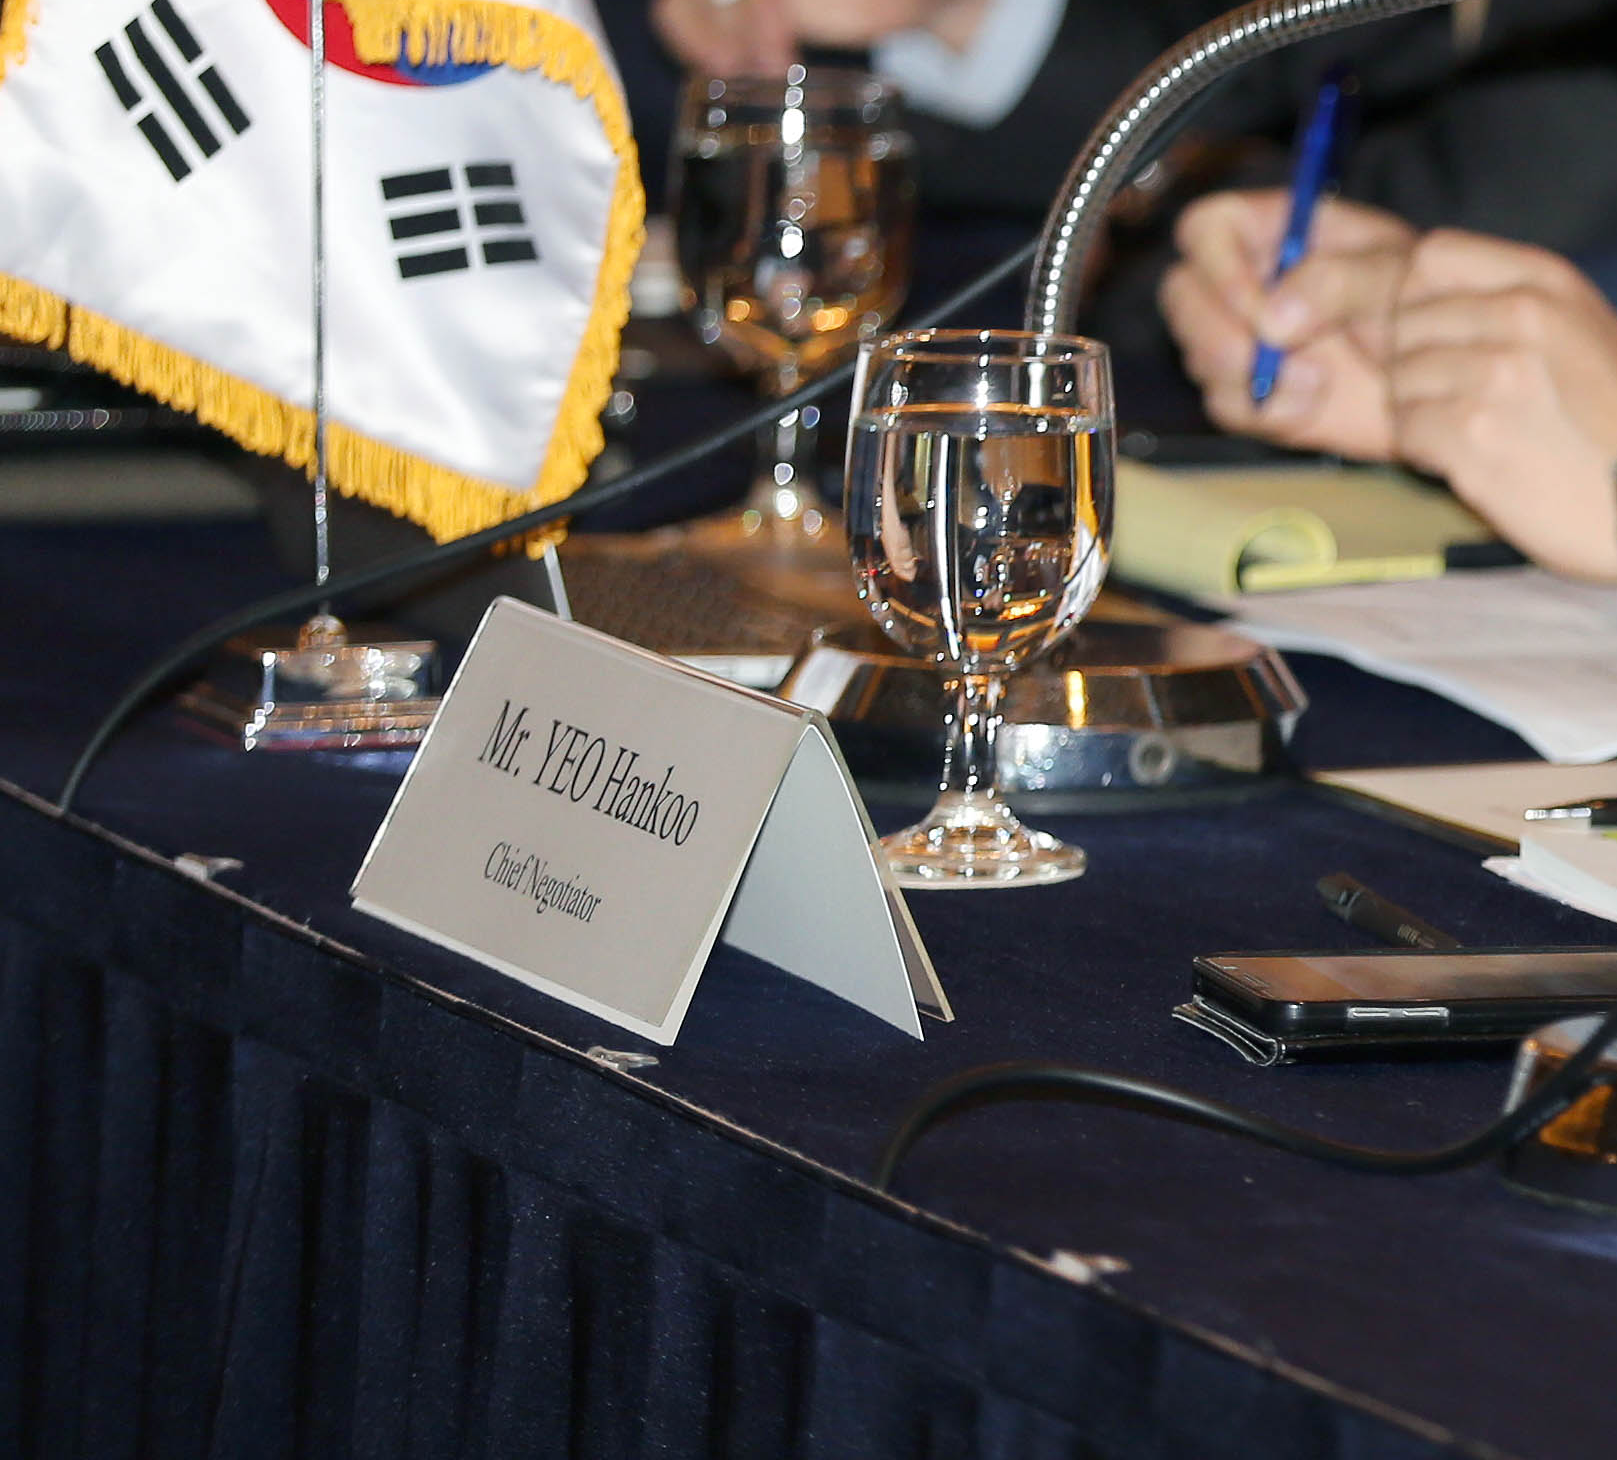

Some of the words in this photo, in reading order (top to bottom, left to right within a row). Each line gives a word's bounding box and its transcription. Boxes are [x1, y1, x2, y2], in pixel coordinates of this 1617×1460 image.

[477, 700, 531, 778] Mr.
[532, 719, 606, 803] YEO
[592, 746, 700, 847] Hankoo
[483, 841, 533, 896] Chief
[522, 857, 603, 924] Negotiator
